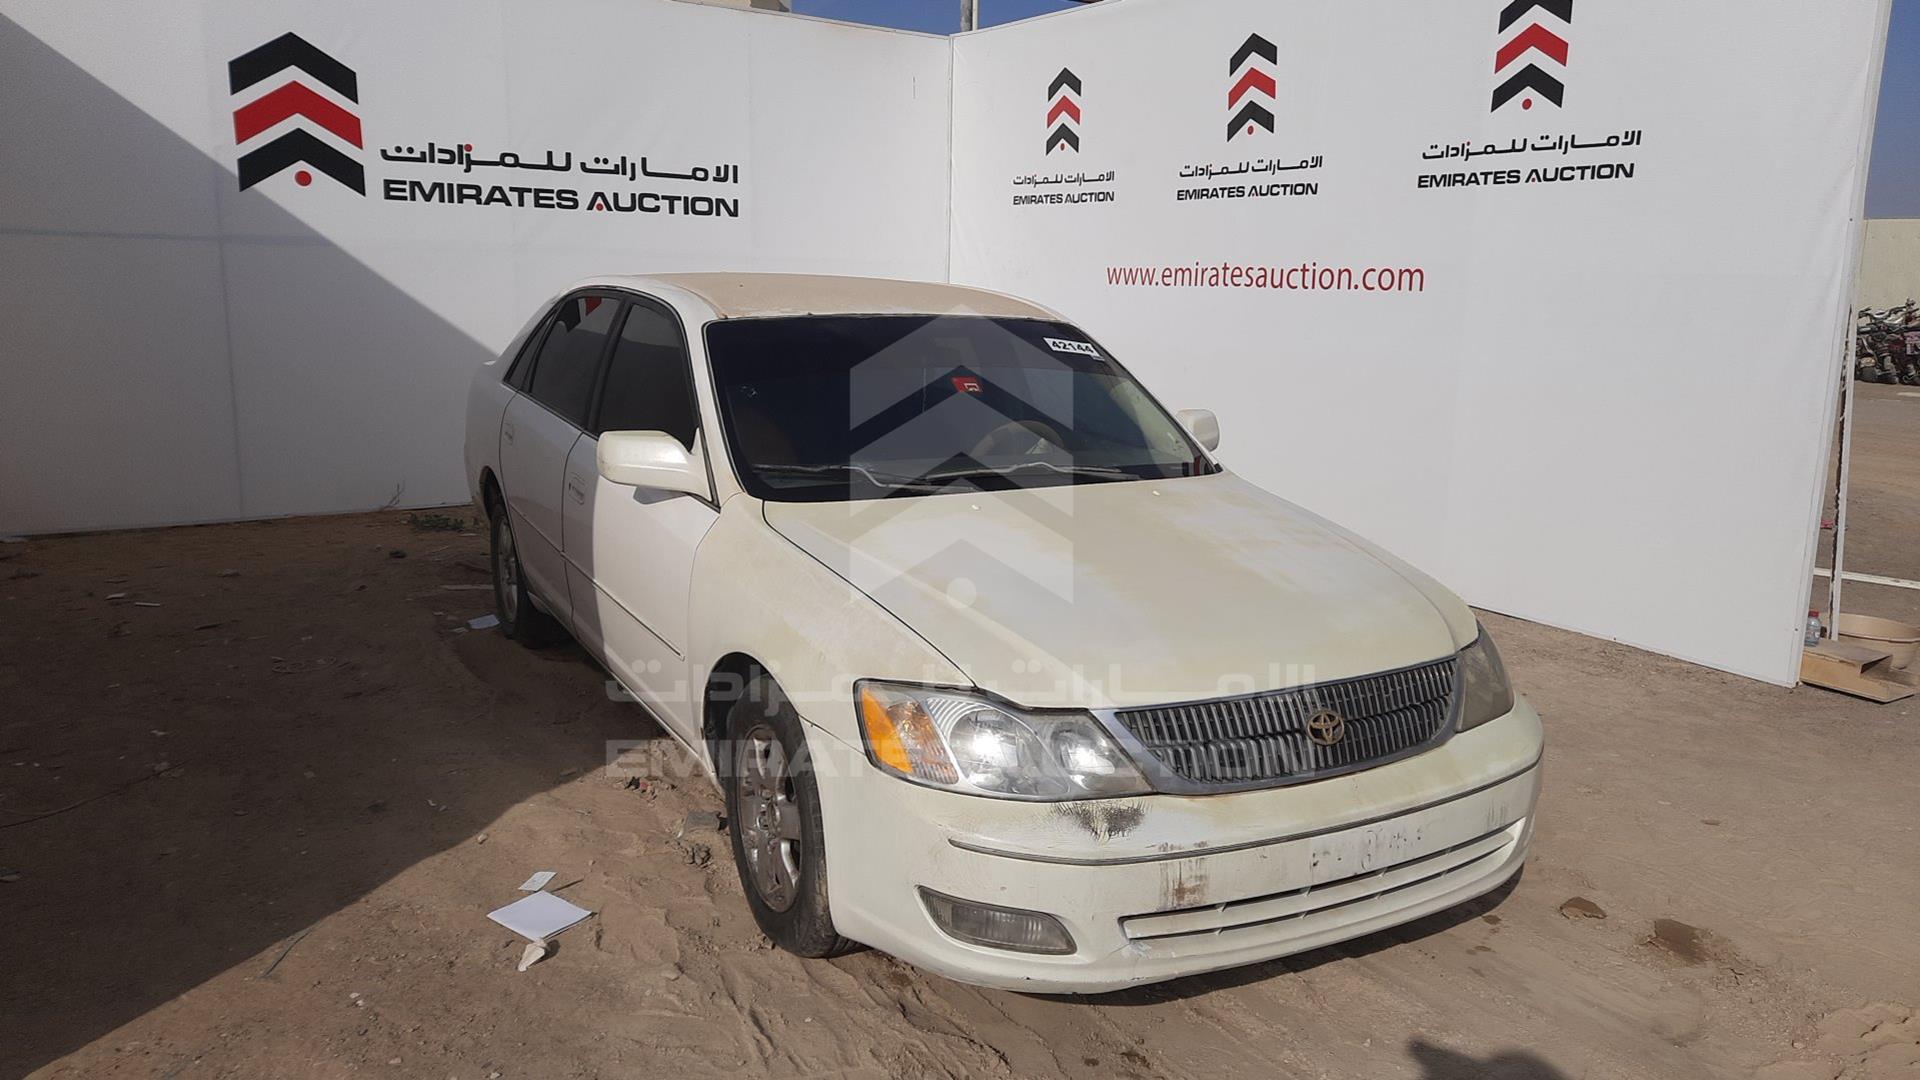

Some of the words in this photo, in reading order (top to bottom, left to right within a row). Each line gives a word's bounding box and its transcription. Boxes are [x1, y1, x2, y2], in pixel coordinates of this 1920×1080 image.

[1417, 169, 1521, 188] EMIRATES
[1525, 163, 1635, 183] AUCTION
[383, 178, 579, 209] EMIRATES
[586, 191, 739, 217] AUCTION
[1012, 193, 1064, 205] EMIRATES
[1064, 191, 1114, 203] AUCTION
[1177, 186, 1246, 200] EMIRATES
[1247, 182, 1319, 197] AUCTION
[1106, 261, 1425, 292] www.emiratesauction.com
[1051, 341, 1094, 353] 42144
